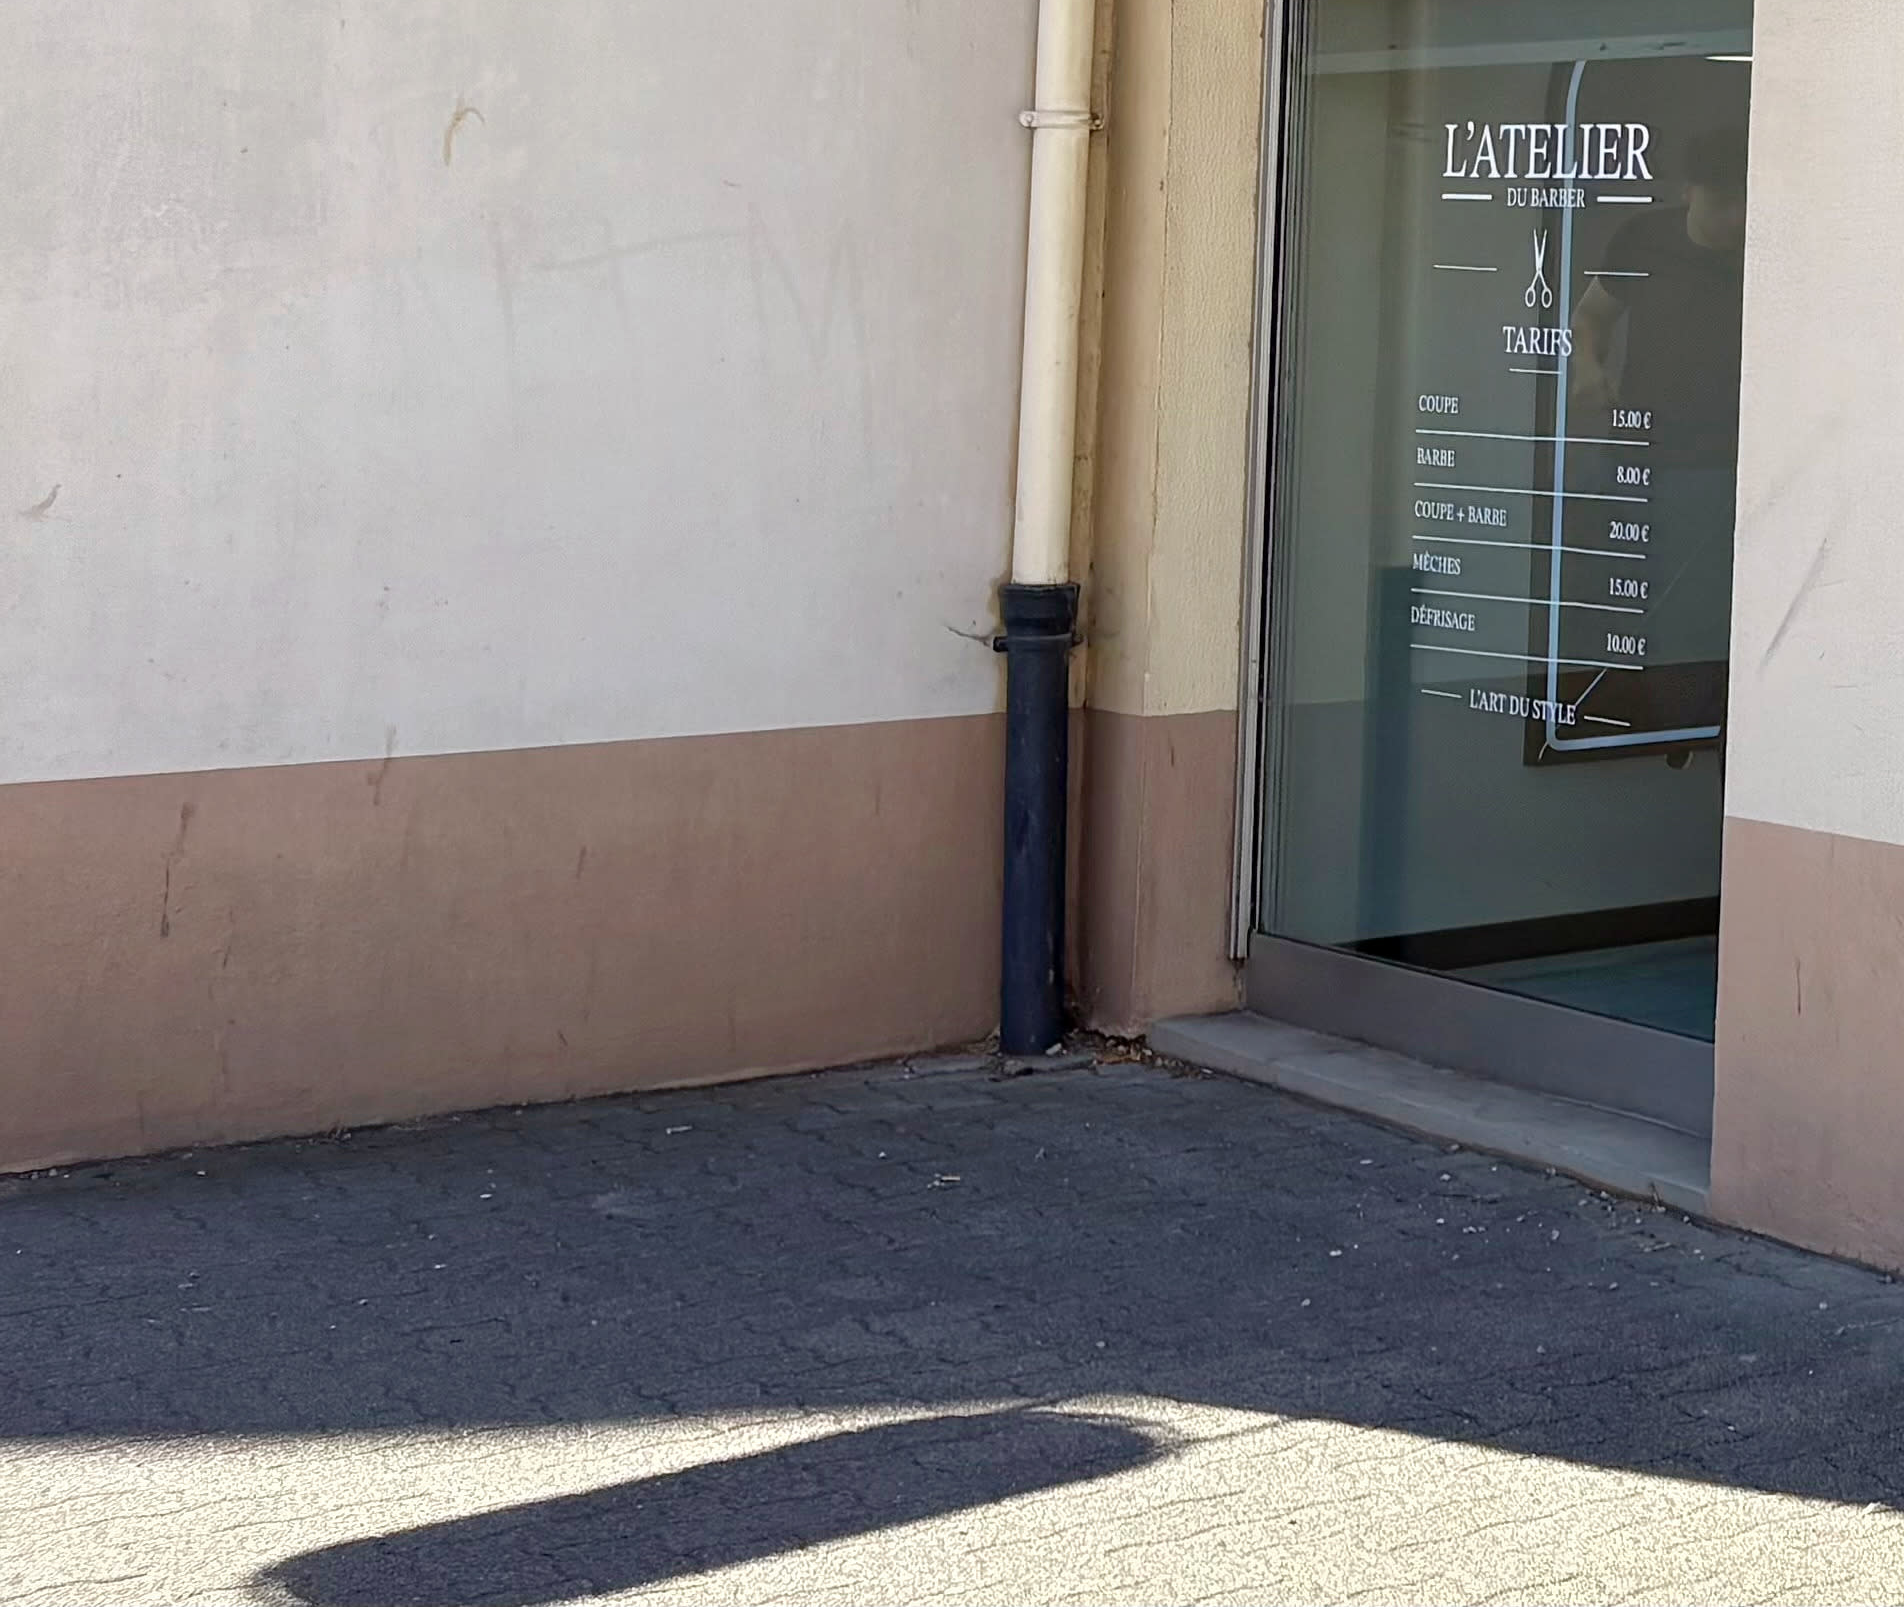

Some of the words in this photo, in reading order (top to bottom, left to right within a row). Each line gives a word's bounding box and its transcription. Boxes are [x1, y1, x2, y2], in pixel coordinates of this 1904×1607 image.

[1442, 121, 1653, 180] L'ATELIER
[1507, 187, 1528, 207] DU
[1531, 189, 1585, 208] BARBER
[1503, 326, 1572, 357] TARIFS
[1418, 394, 1459, 415] COUPE
[1612, 409, 1642, 429] 15.00
[1643, 411, 1651, 430] €
[1417, 446, 1456, 468] BARBE
[1616, 465, 1642, 485] 8.00
[1642, 468, 1651, 486] €
[1415, 500, 1454, 521] COUPE
[1457, 510, 1465, 523] +
[1467, 506, 1507, 527] BARBE
[1610, 521, 1641, 541] 20.00
[1641, 524, 1649, 542] €
[1609, 578, 1639, 599] 15.00
[1640, 581, 1648, 599] €
[1410, 604, 1476, 632] DÉFRISAGE
[1606, 632, 1637, 654] 10.00
[1637, 638, 1646, 656] €
[1509, 696, 1530, 718] DU
[1532, 699, 1577, 725] STYLE
